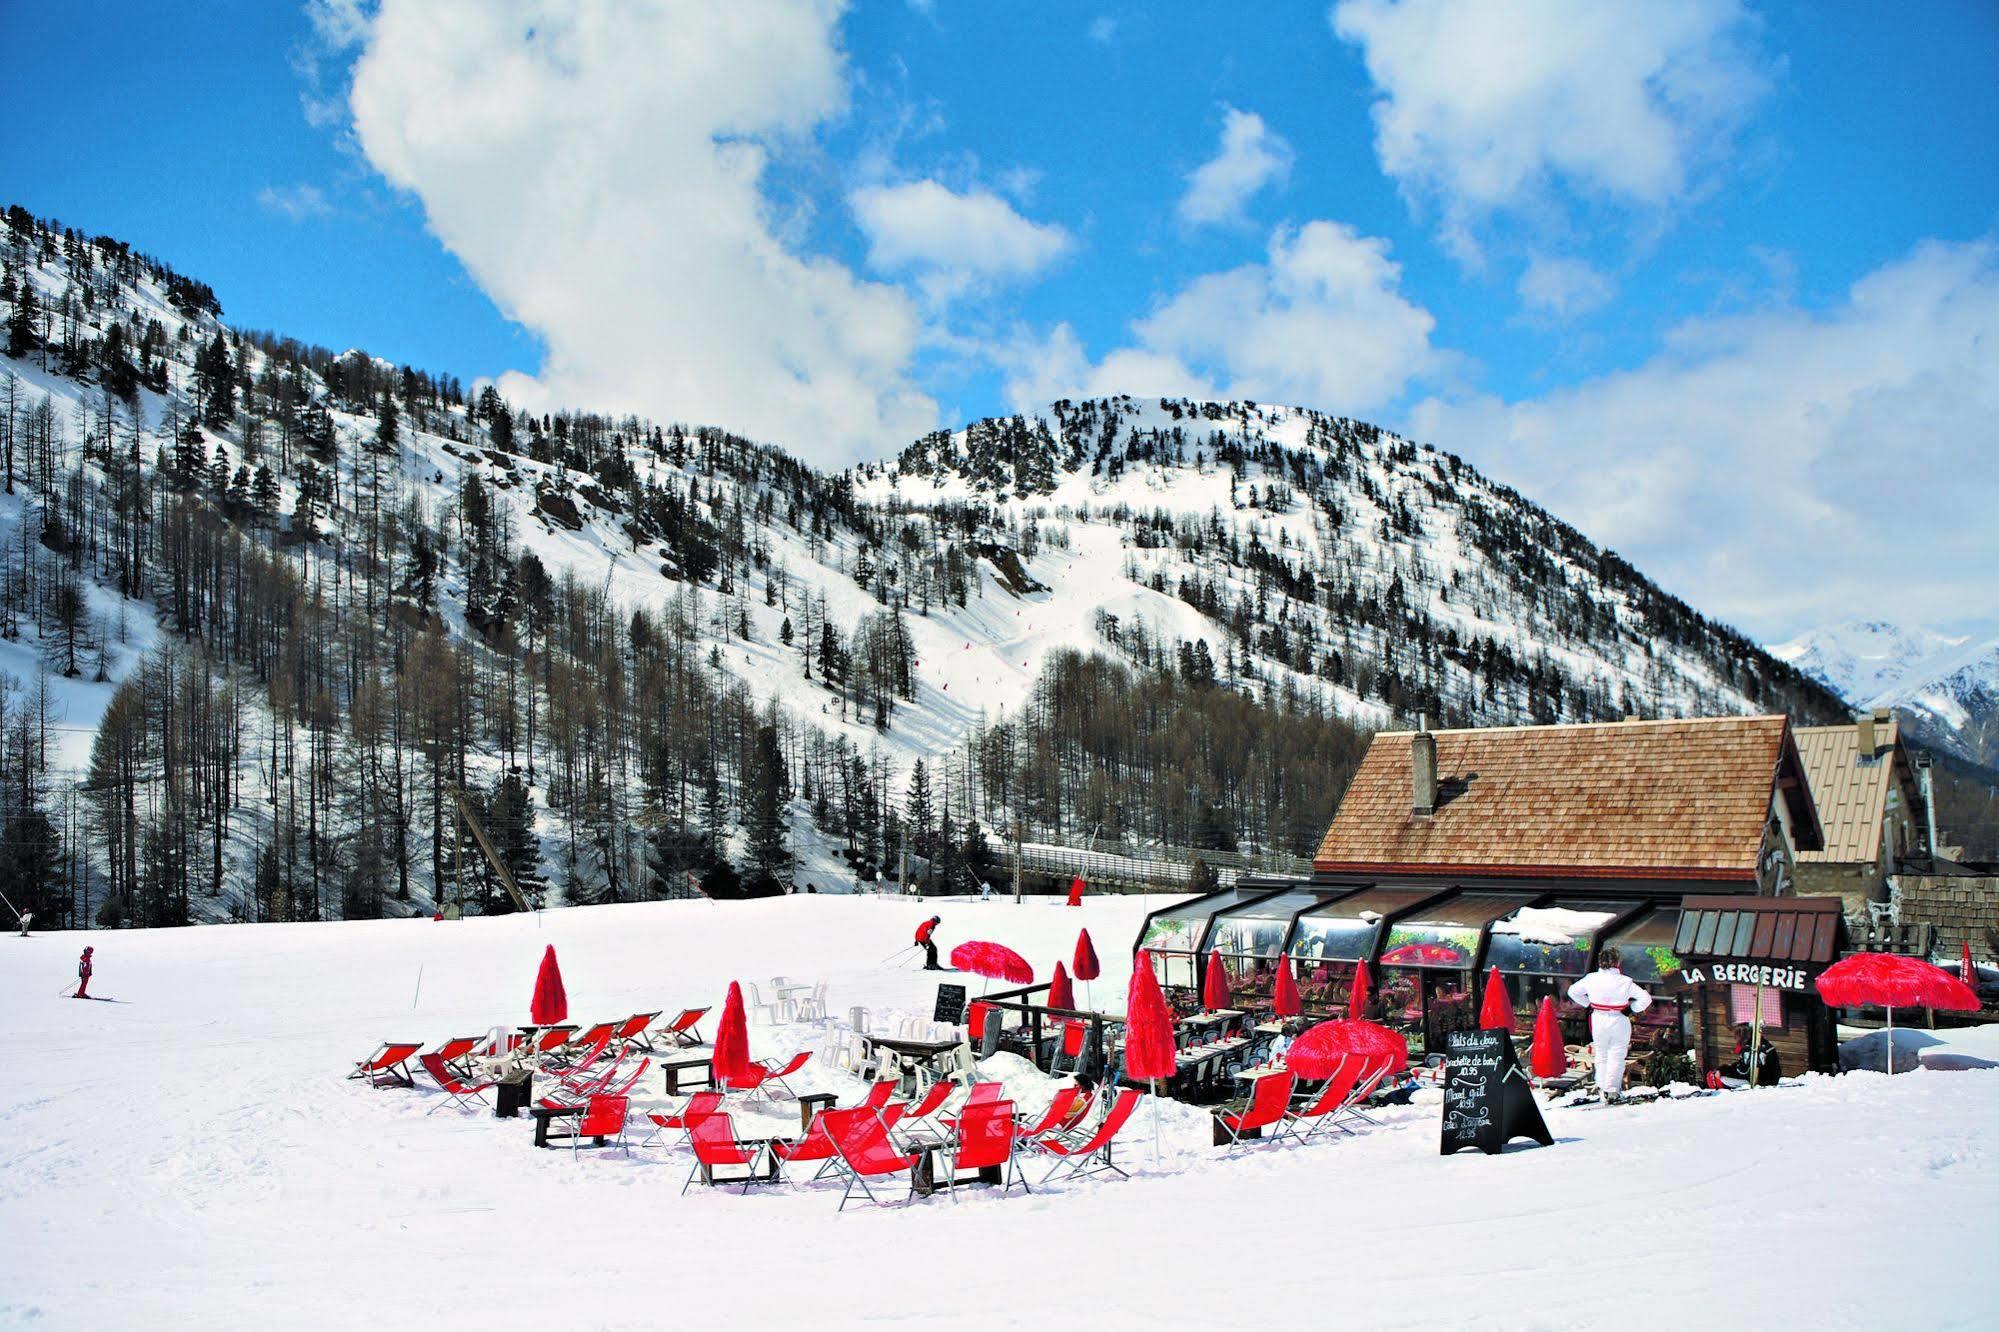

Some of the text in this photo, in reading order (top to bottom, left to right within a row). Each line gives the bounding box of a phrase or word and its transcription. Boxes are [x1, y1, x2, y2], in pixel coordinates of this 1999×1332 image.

[1681, 968, 1706, 985] LA
[1467, 1032, 1479, 1046] du
[1472, 1054, 1482, 1066] de
